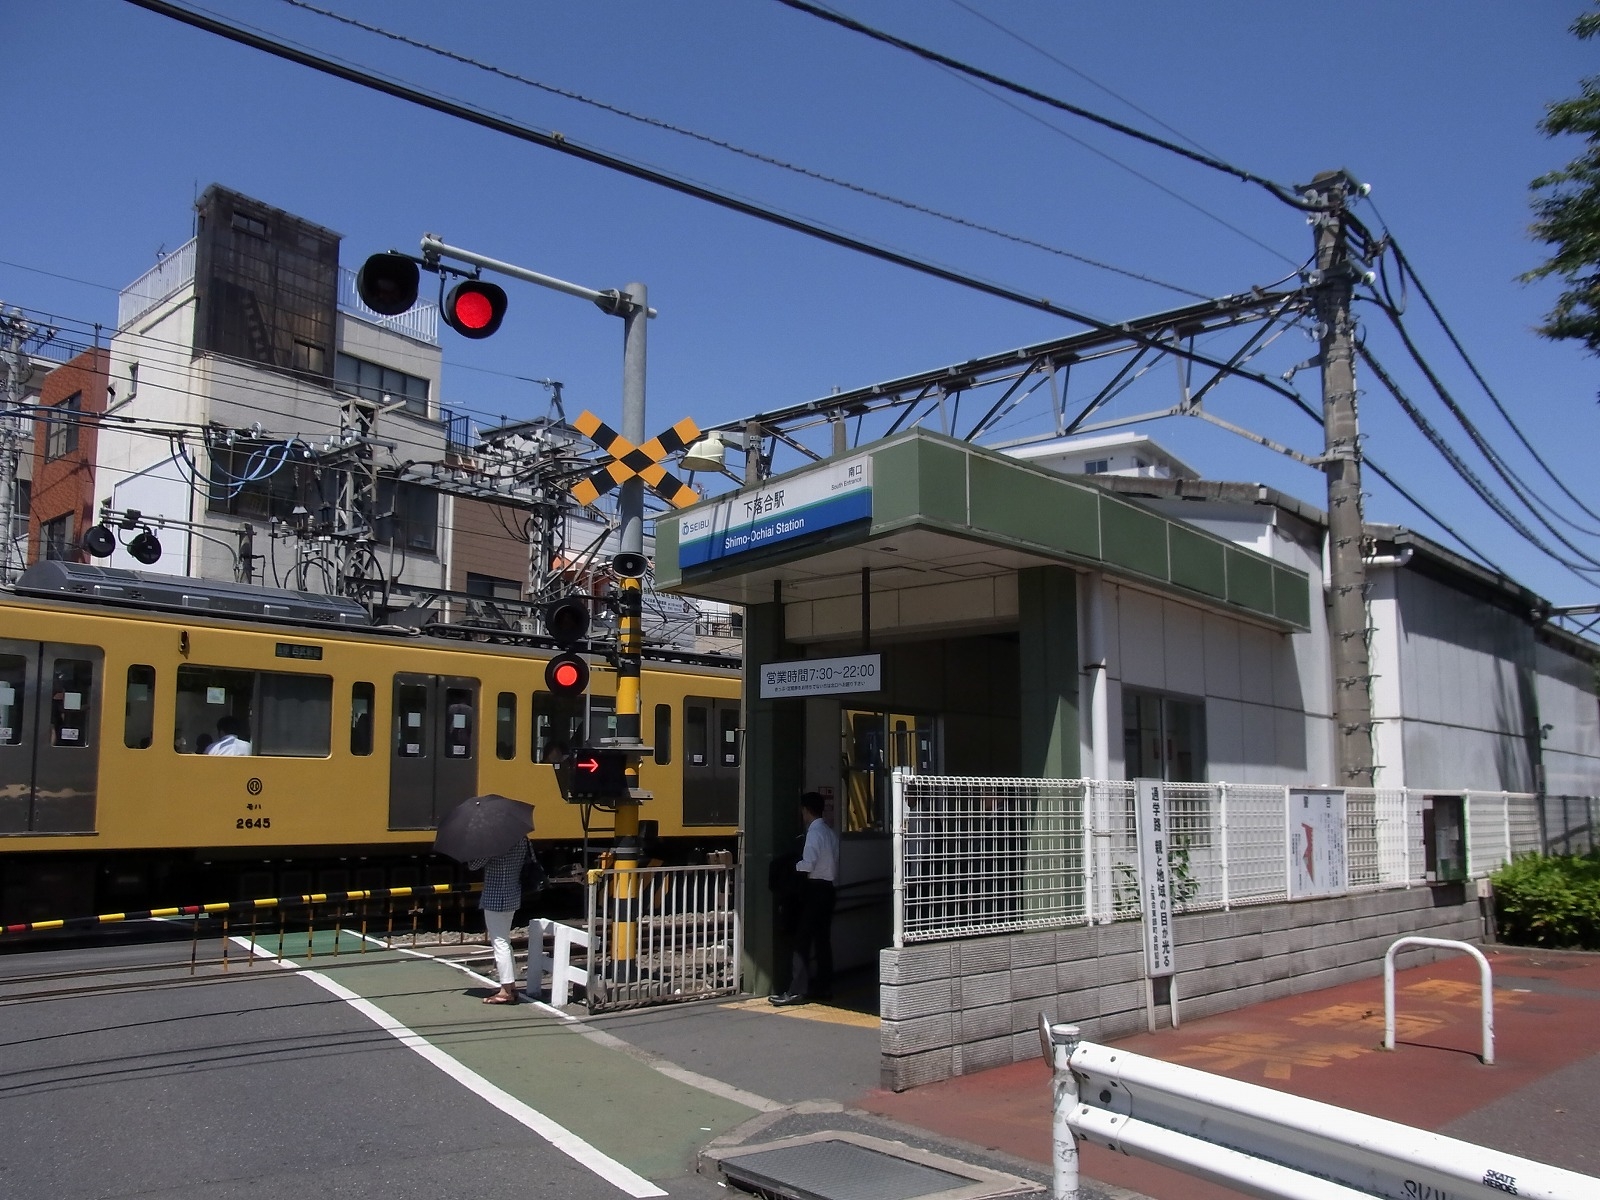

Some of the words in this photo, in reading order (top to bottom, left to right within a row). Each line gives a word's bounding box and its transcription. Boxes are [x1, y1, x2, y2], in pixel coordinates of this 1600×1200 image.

[848, 464, 862, 478] 南口
[831, 481, 843, 491] South
[843, 476, 862, 488] Entrance
[743, 489, 785, 519] 下落合駅
[690, 519, 710, 533] SEIBU
[725, 525, 774, 550] Shimo-Ochiai
[776, 518, 805, 535] Station
[246, 803, 262, 811] モハ
[1151, 786, 1162, 832] 通学路
[236, 817, 271, 830] 2645
[1482, 1175, 1518, 1195] HEROES
[1485, 1169, 1516, 1186] SKATE
